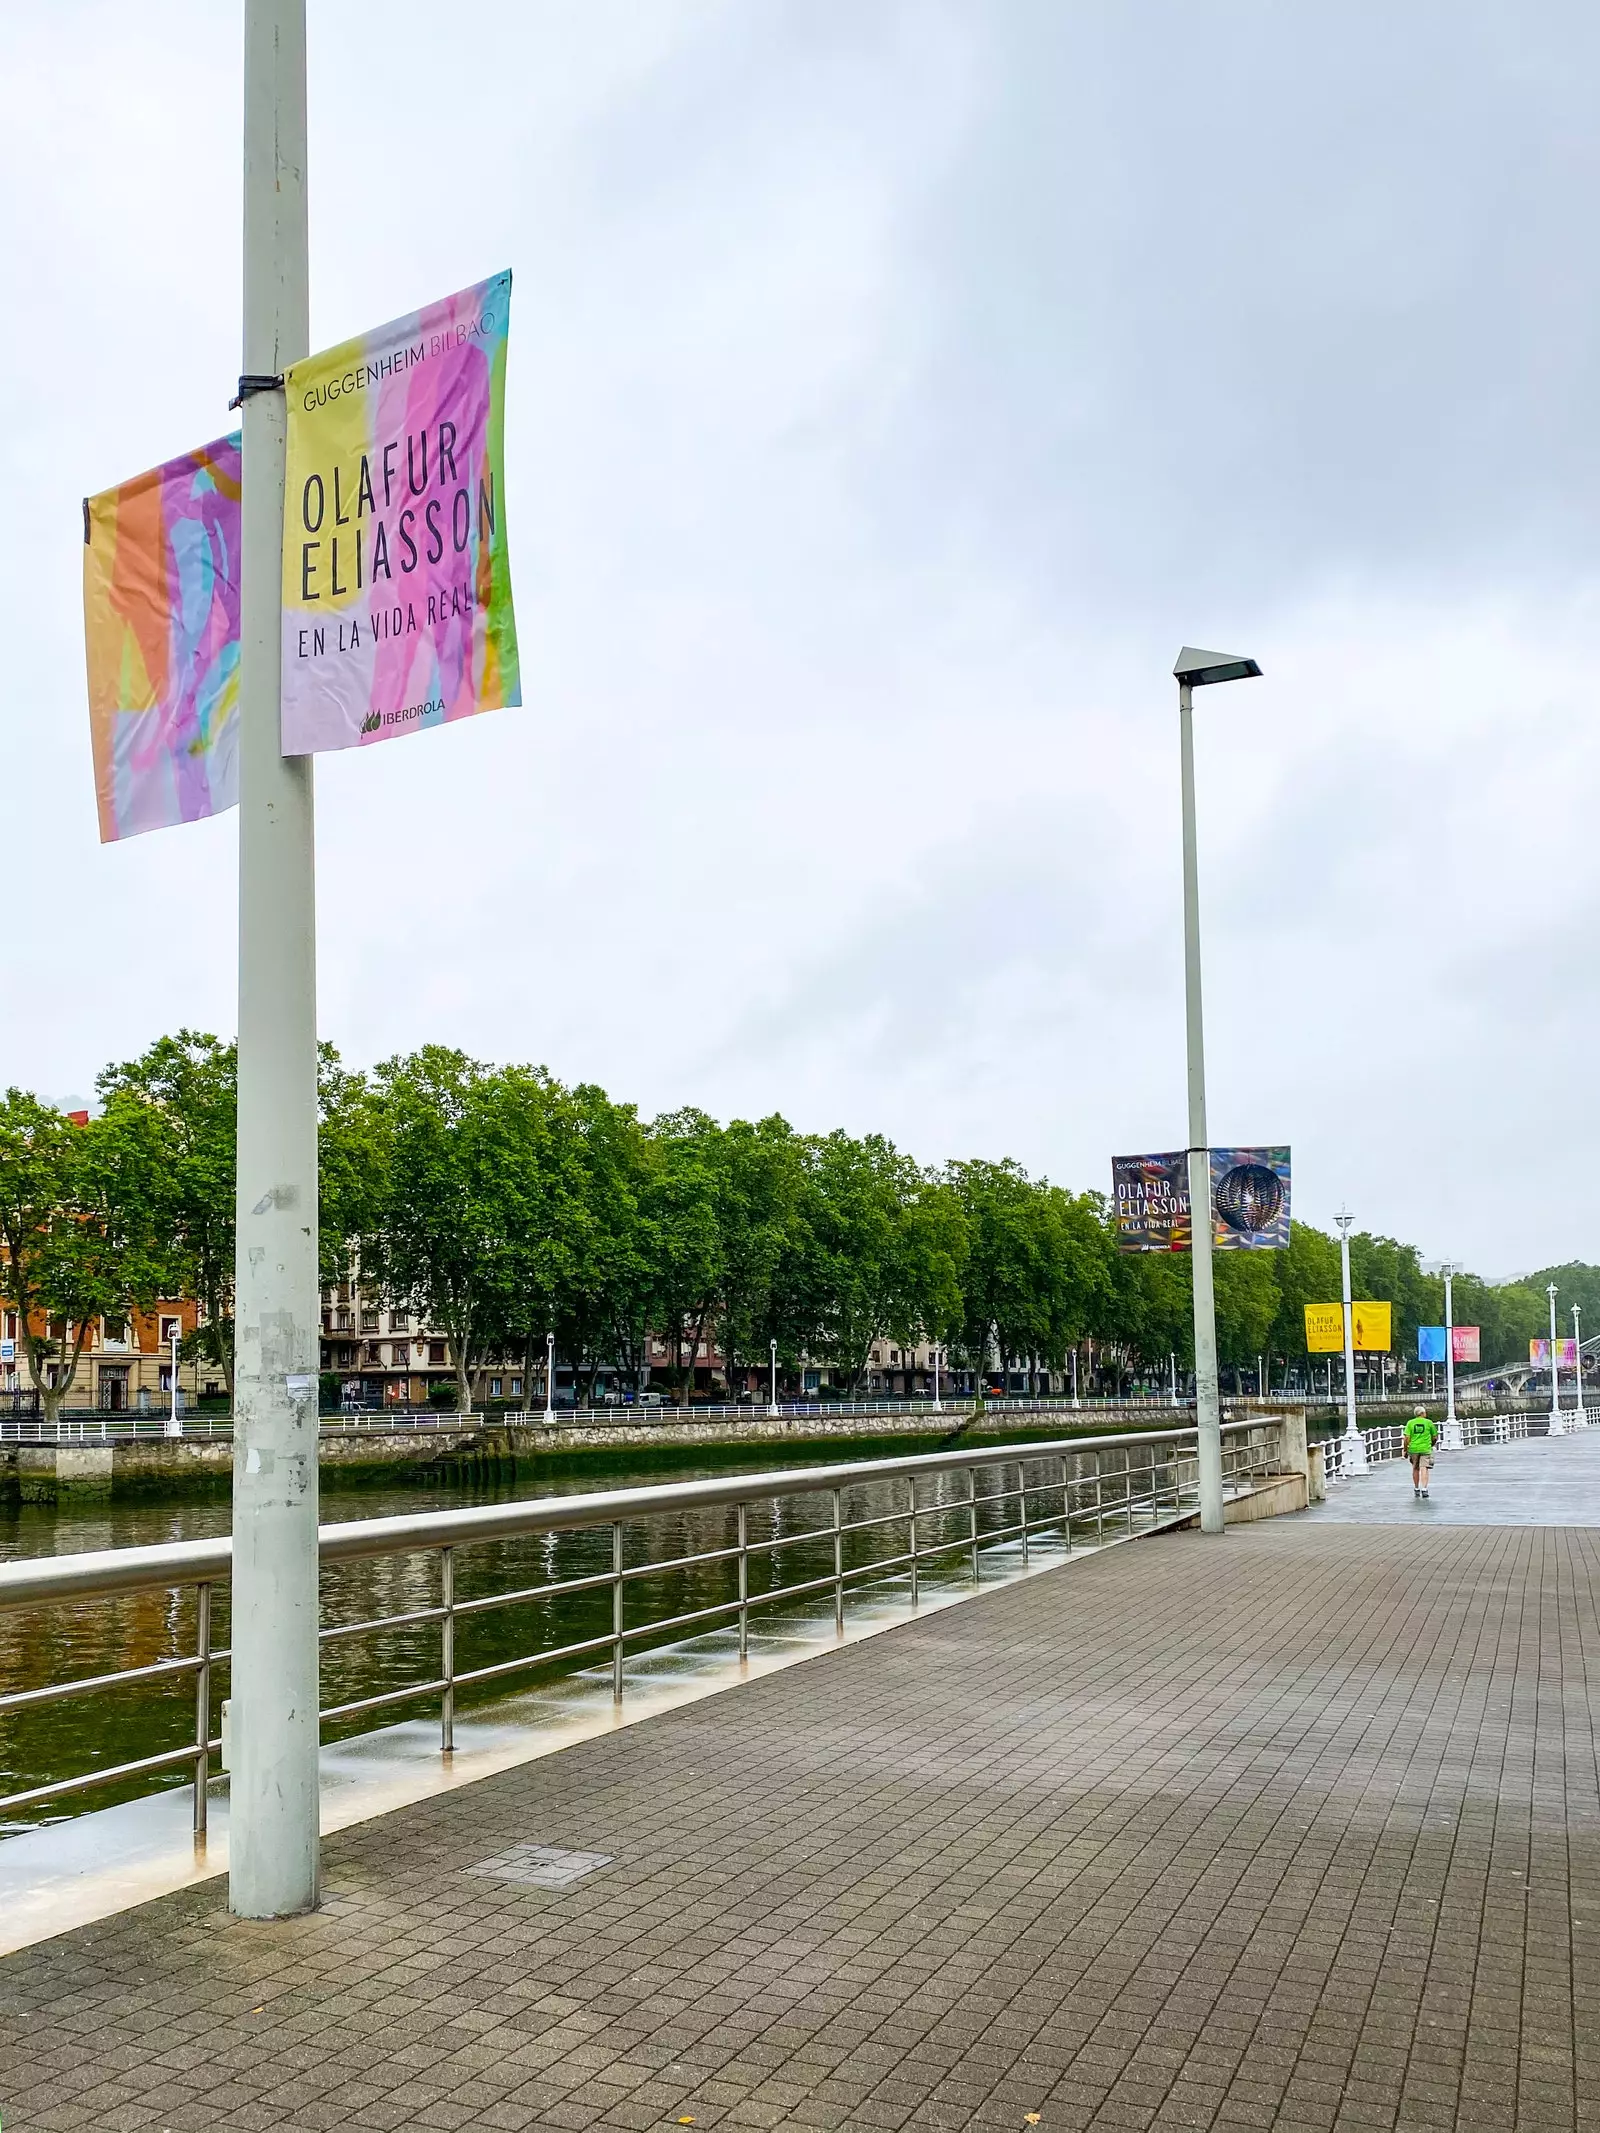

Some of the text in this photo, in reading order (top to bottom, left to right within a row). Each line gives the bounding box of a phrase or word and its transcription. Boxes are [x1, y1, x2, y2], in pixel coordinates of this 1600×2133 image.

[303, 312, 495, 412] GUGGENHEIM BILBAO
[302, 421, 458, 533] OLAFUR
[302, 471, 495, 601] ELIASSON
[298, 582, 472, 658] EN LA VIDA REAL
[383, 698, 446, 726] IBERDROLA
[1116, 1160, 1161, 1170] GUGGENHEIM
[1118, 1181, 1170, 1199] OLAFUR
[1119, 1196, 1187, 1217] ELIASSON
[1121, 1219, 1179, 1230] EN LA VIDA REAL
[1308, 1317, 1334, 1325] OLAFUR
[1308, 1325, 1342, 1333] ELIASSON
